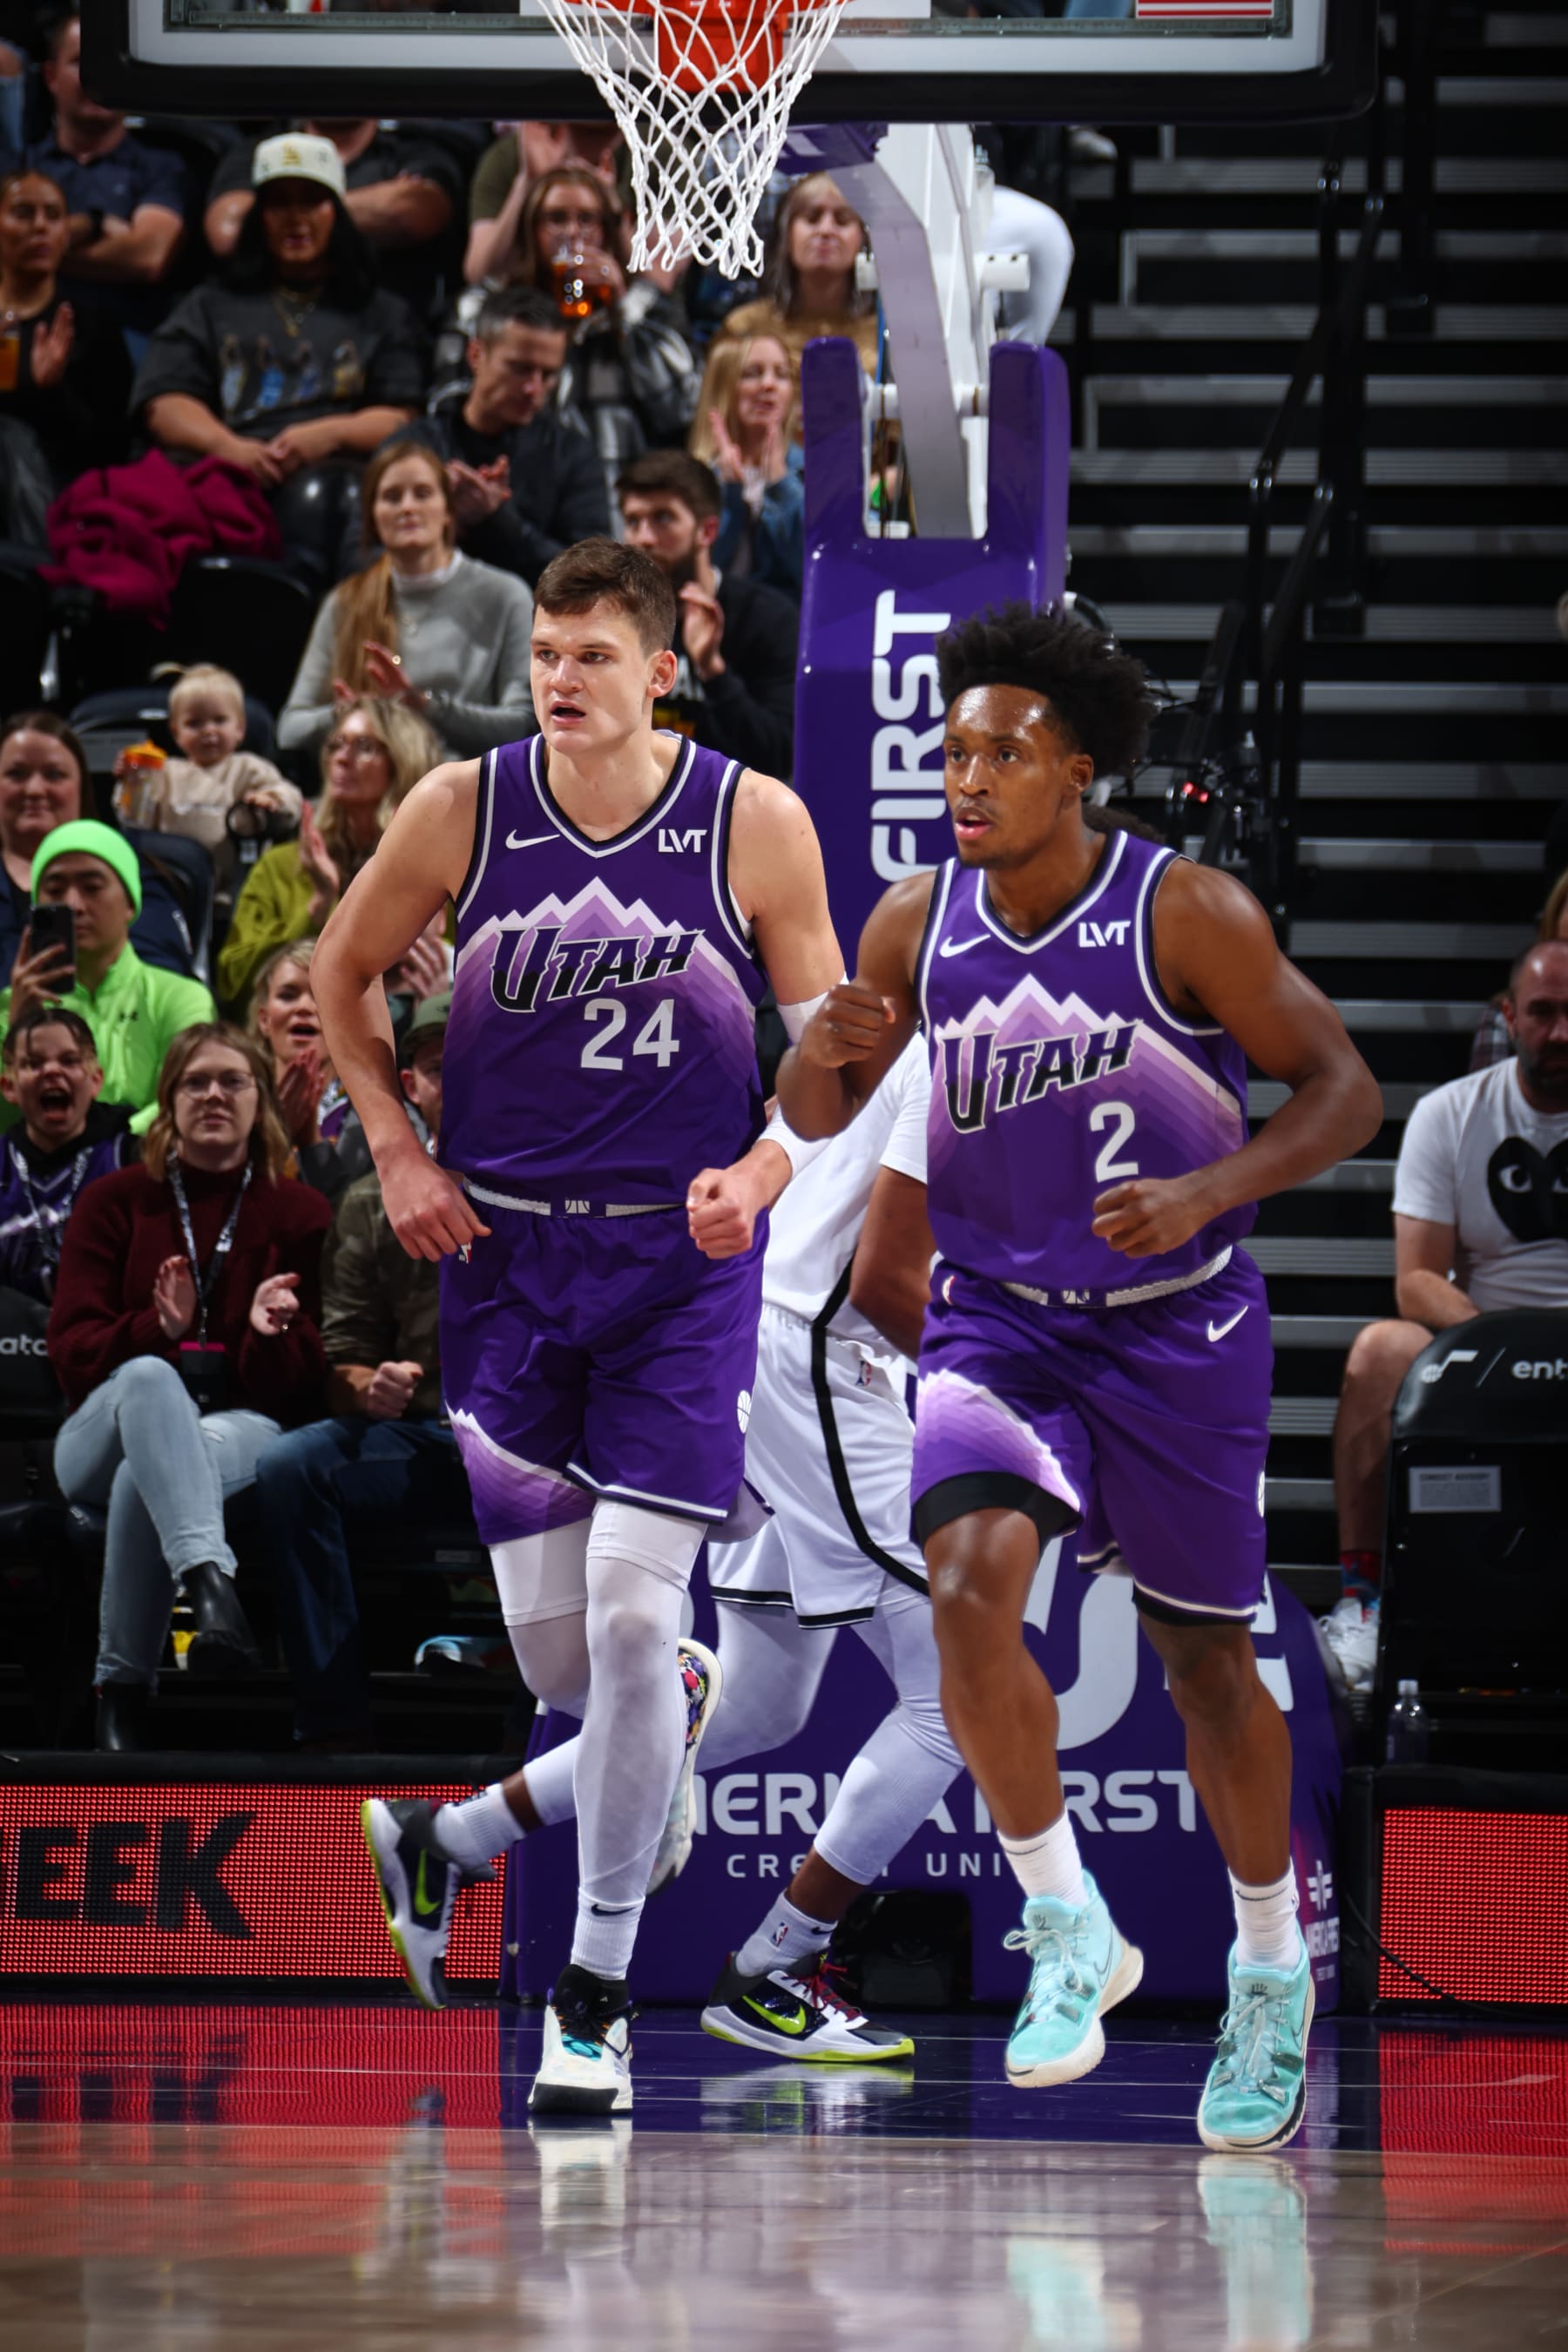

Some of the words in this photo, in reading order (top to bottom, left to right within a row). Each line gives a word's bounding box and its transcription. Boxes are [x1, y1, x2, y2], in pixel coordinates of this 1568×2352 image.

[871, 589, 952, 883] FIRST
[658, 828, 707, 853] LVT
[1078, 921, 1131, 948] LVT
[580, 997, 679, 1071] 24
[1090, 1101, 1139, 1183] 2
[0, 1812, 256, 1940] EEK
[926, 1853, 1001, 1877] UNI
